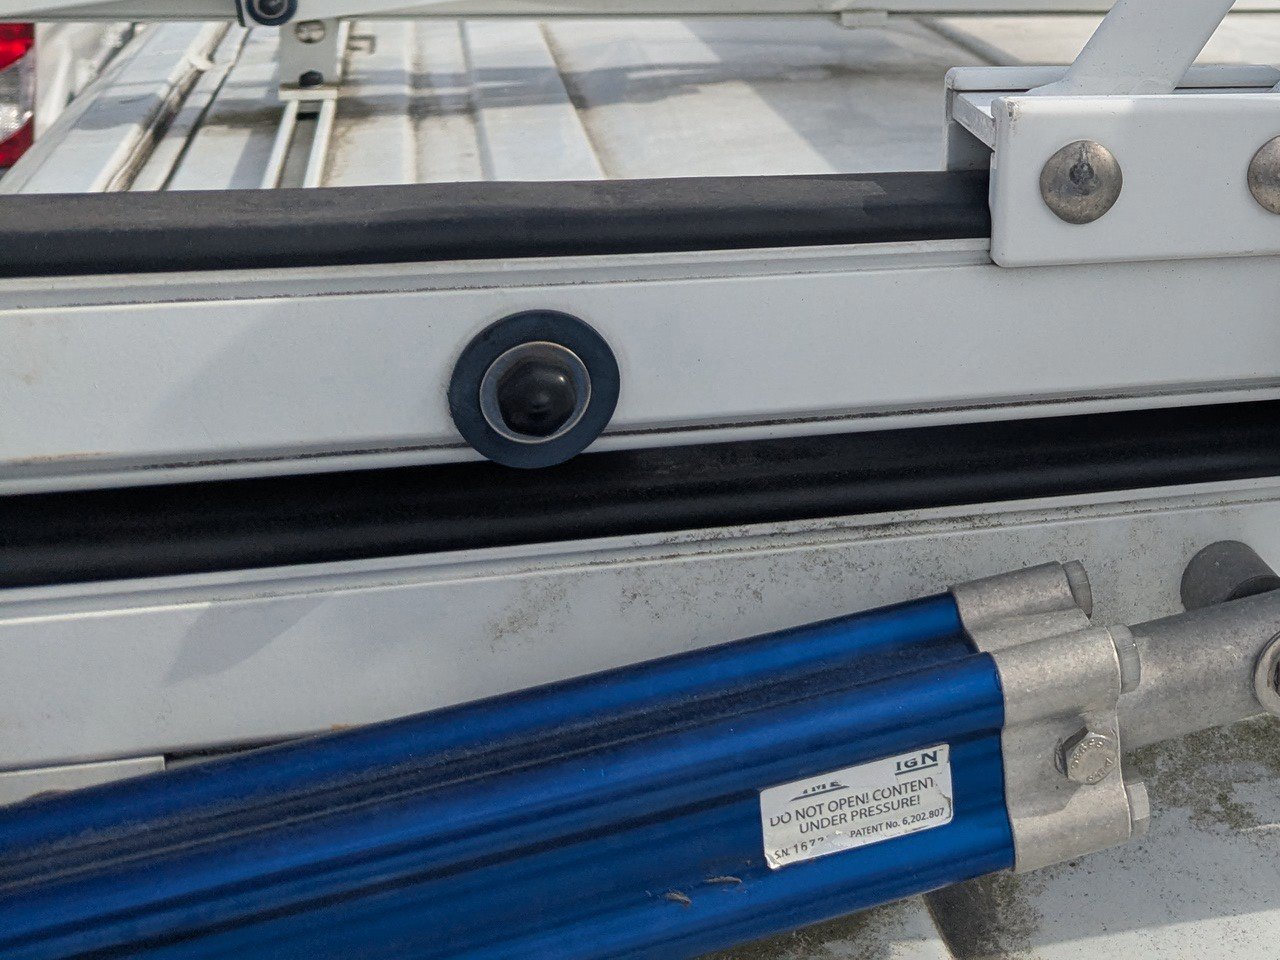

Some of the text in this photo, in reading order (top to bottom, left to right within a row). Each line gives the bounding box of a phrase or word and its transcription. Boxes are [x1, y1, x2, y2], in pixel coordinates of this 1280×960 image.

[770, 777, 937, 827] DO NOT OPEN! CONTENT
[799, 795, 920, 833] UNDER PRESSURE!
[850, 823, 883, 837] PATENT
[886, 821, 900, 830] No.
